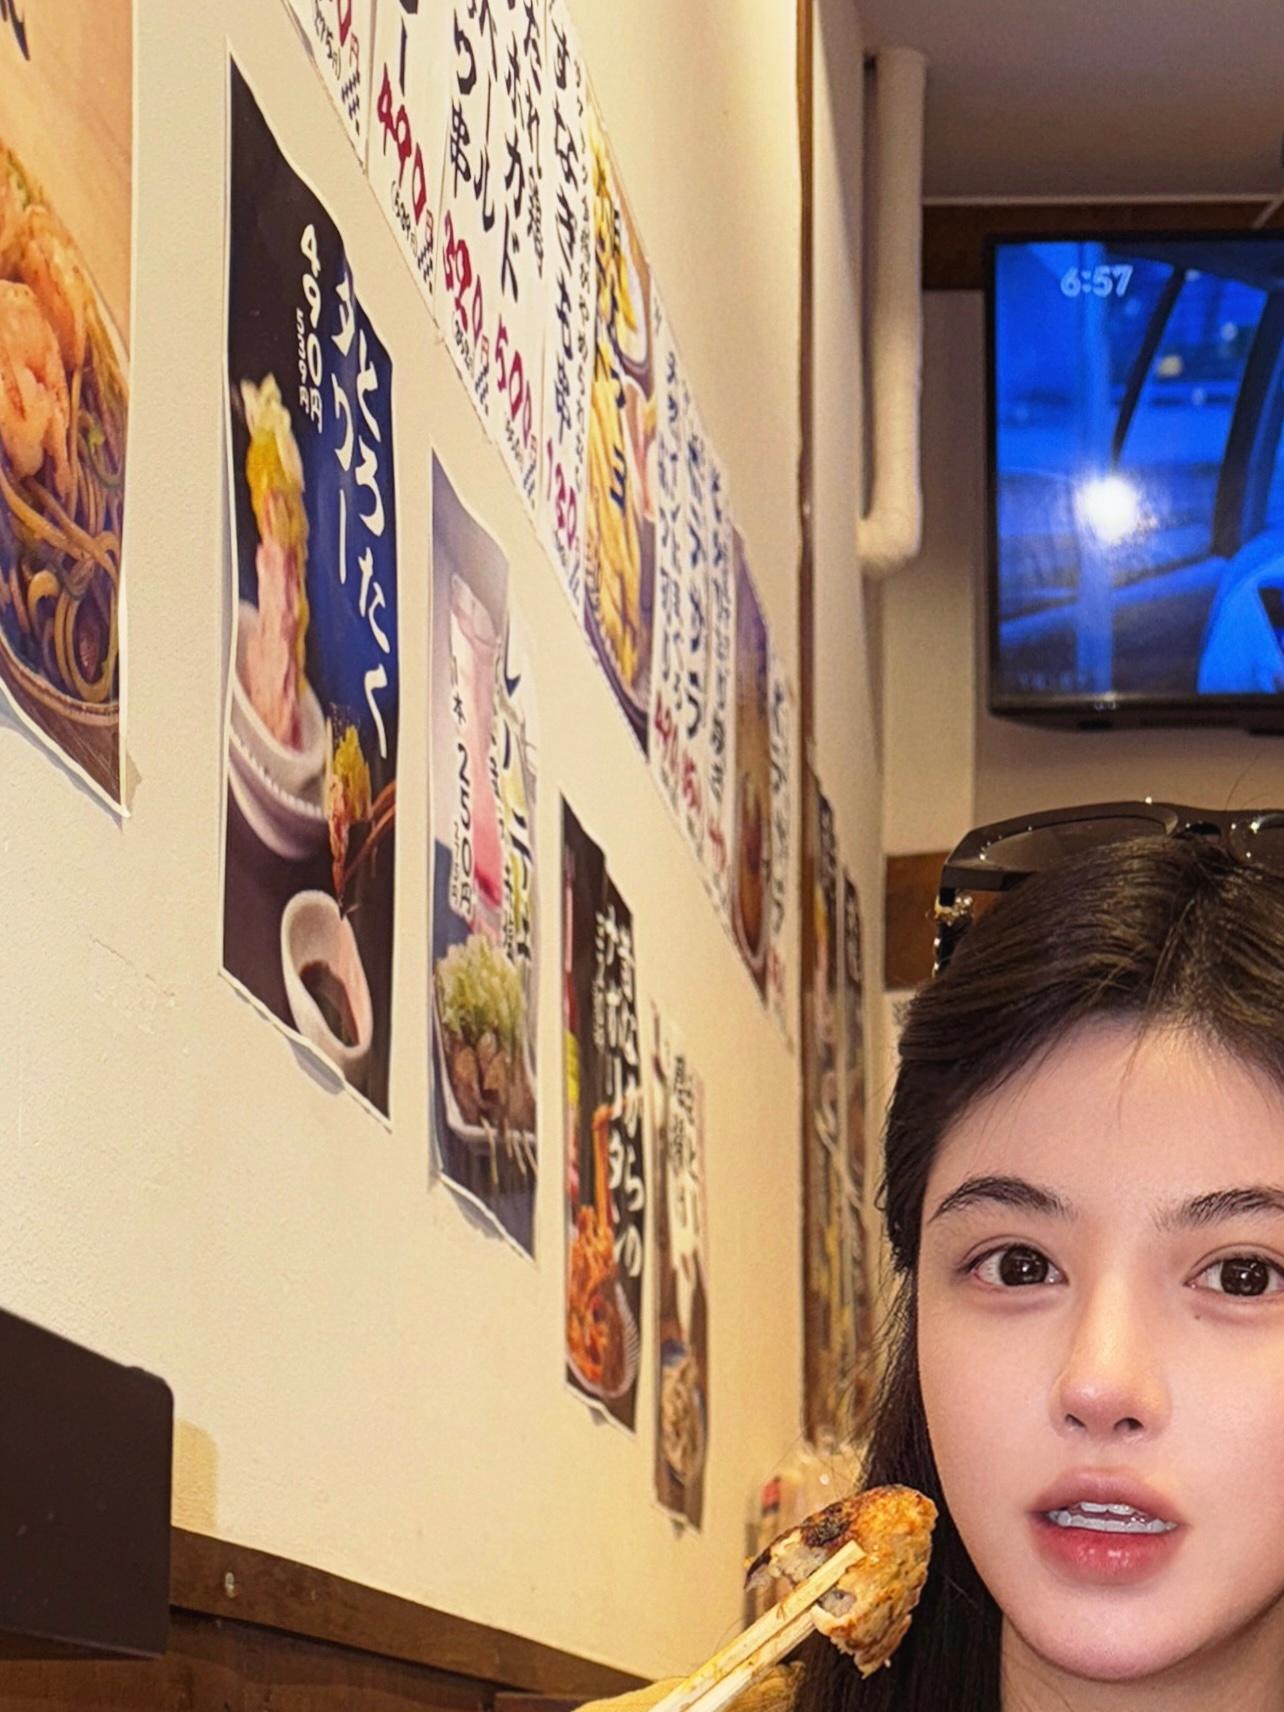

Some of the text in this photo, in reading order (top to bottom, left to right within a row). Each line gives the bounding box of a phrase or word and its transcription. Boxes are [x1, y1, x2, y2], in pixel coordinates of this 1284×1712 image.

[1060, 264, 1133, 298] 6:57
[356, 329, 390, 760] とろたく
